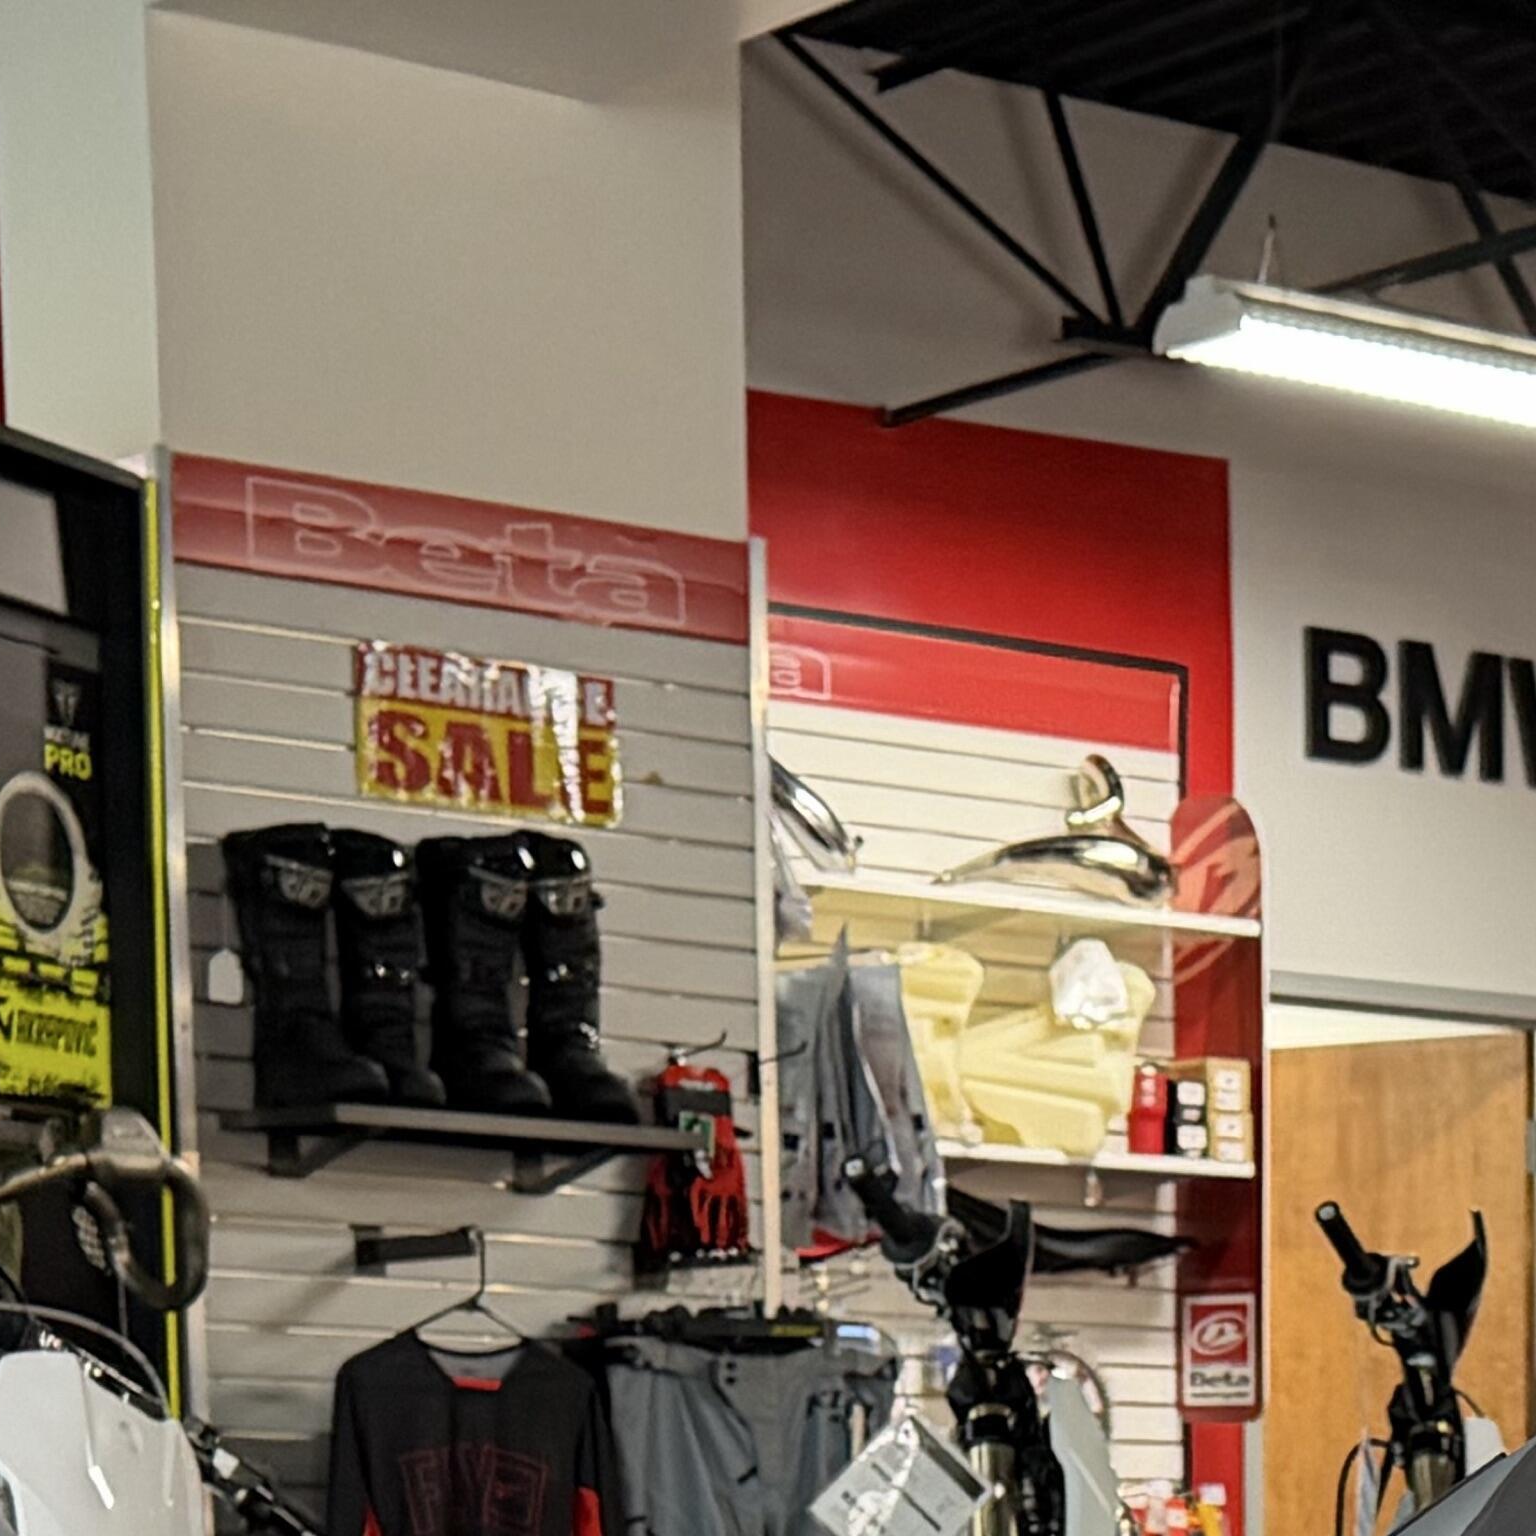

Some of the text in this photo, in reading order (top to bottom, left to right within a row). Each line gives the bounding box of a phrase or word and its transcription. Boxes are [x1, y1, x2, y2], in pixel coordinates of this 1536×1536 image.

[246, 476, 686, 624] Beta
[44, 741, 92, 781] PRO
[370, 710, 611, 815] SALE
